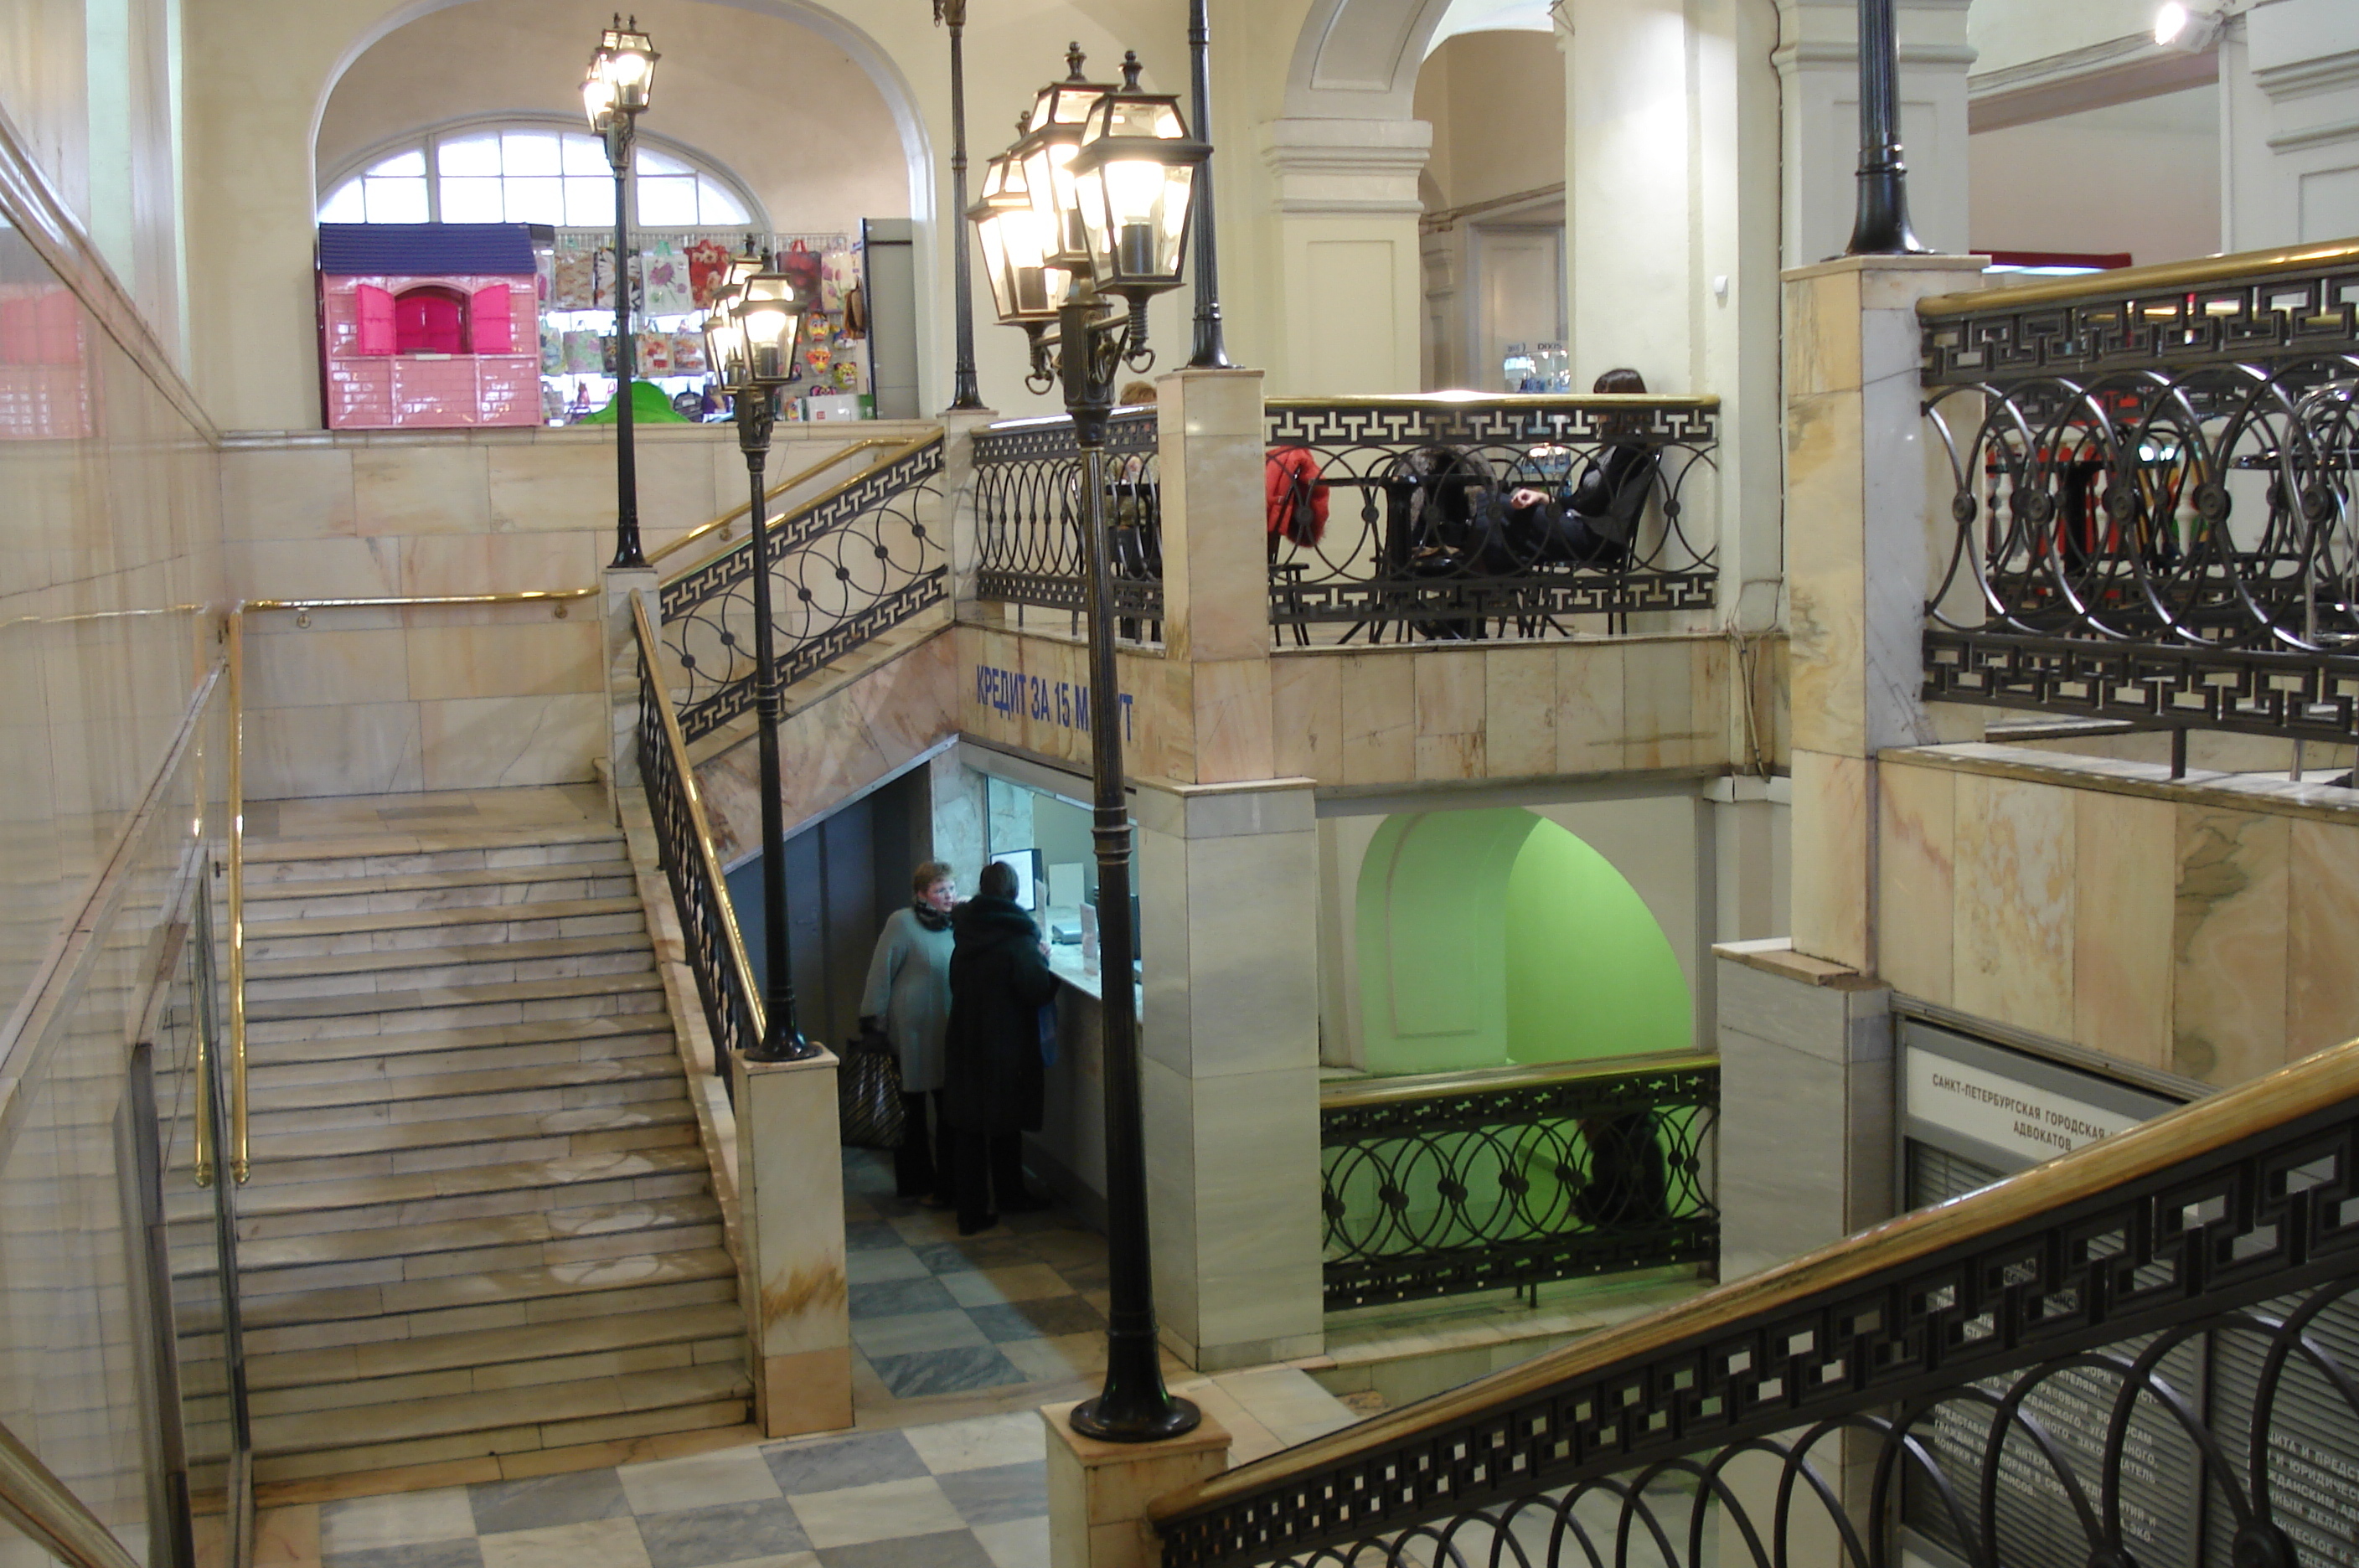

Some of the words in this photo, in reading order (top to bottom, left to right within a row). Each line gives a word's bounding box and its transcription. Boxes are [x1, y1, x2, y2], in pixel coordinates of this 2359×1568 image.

[977, 665, 1025, 720] КРЕДИТ
[1031, 676, 1050, 722] ЗА
[1055, 683, 1070, 727] 15
[1933, 1074, 2041, 1119] САНКТ-ПЕТЕРБУРГСКАЯ
[2046, 1110, 2105, 1140] ГОРОДСКАЯ
[2014, 1121, 2072, 1151] АДВОКАТОВ
[2301, 1445, 2308, 1457] И
